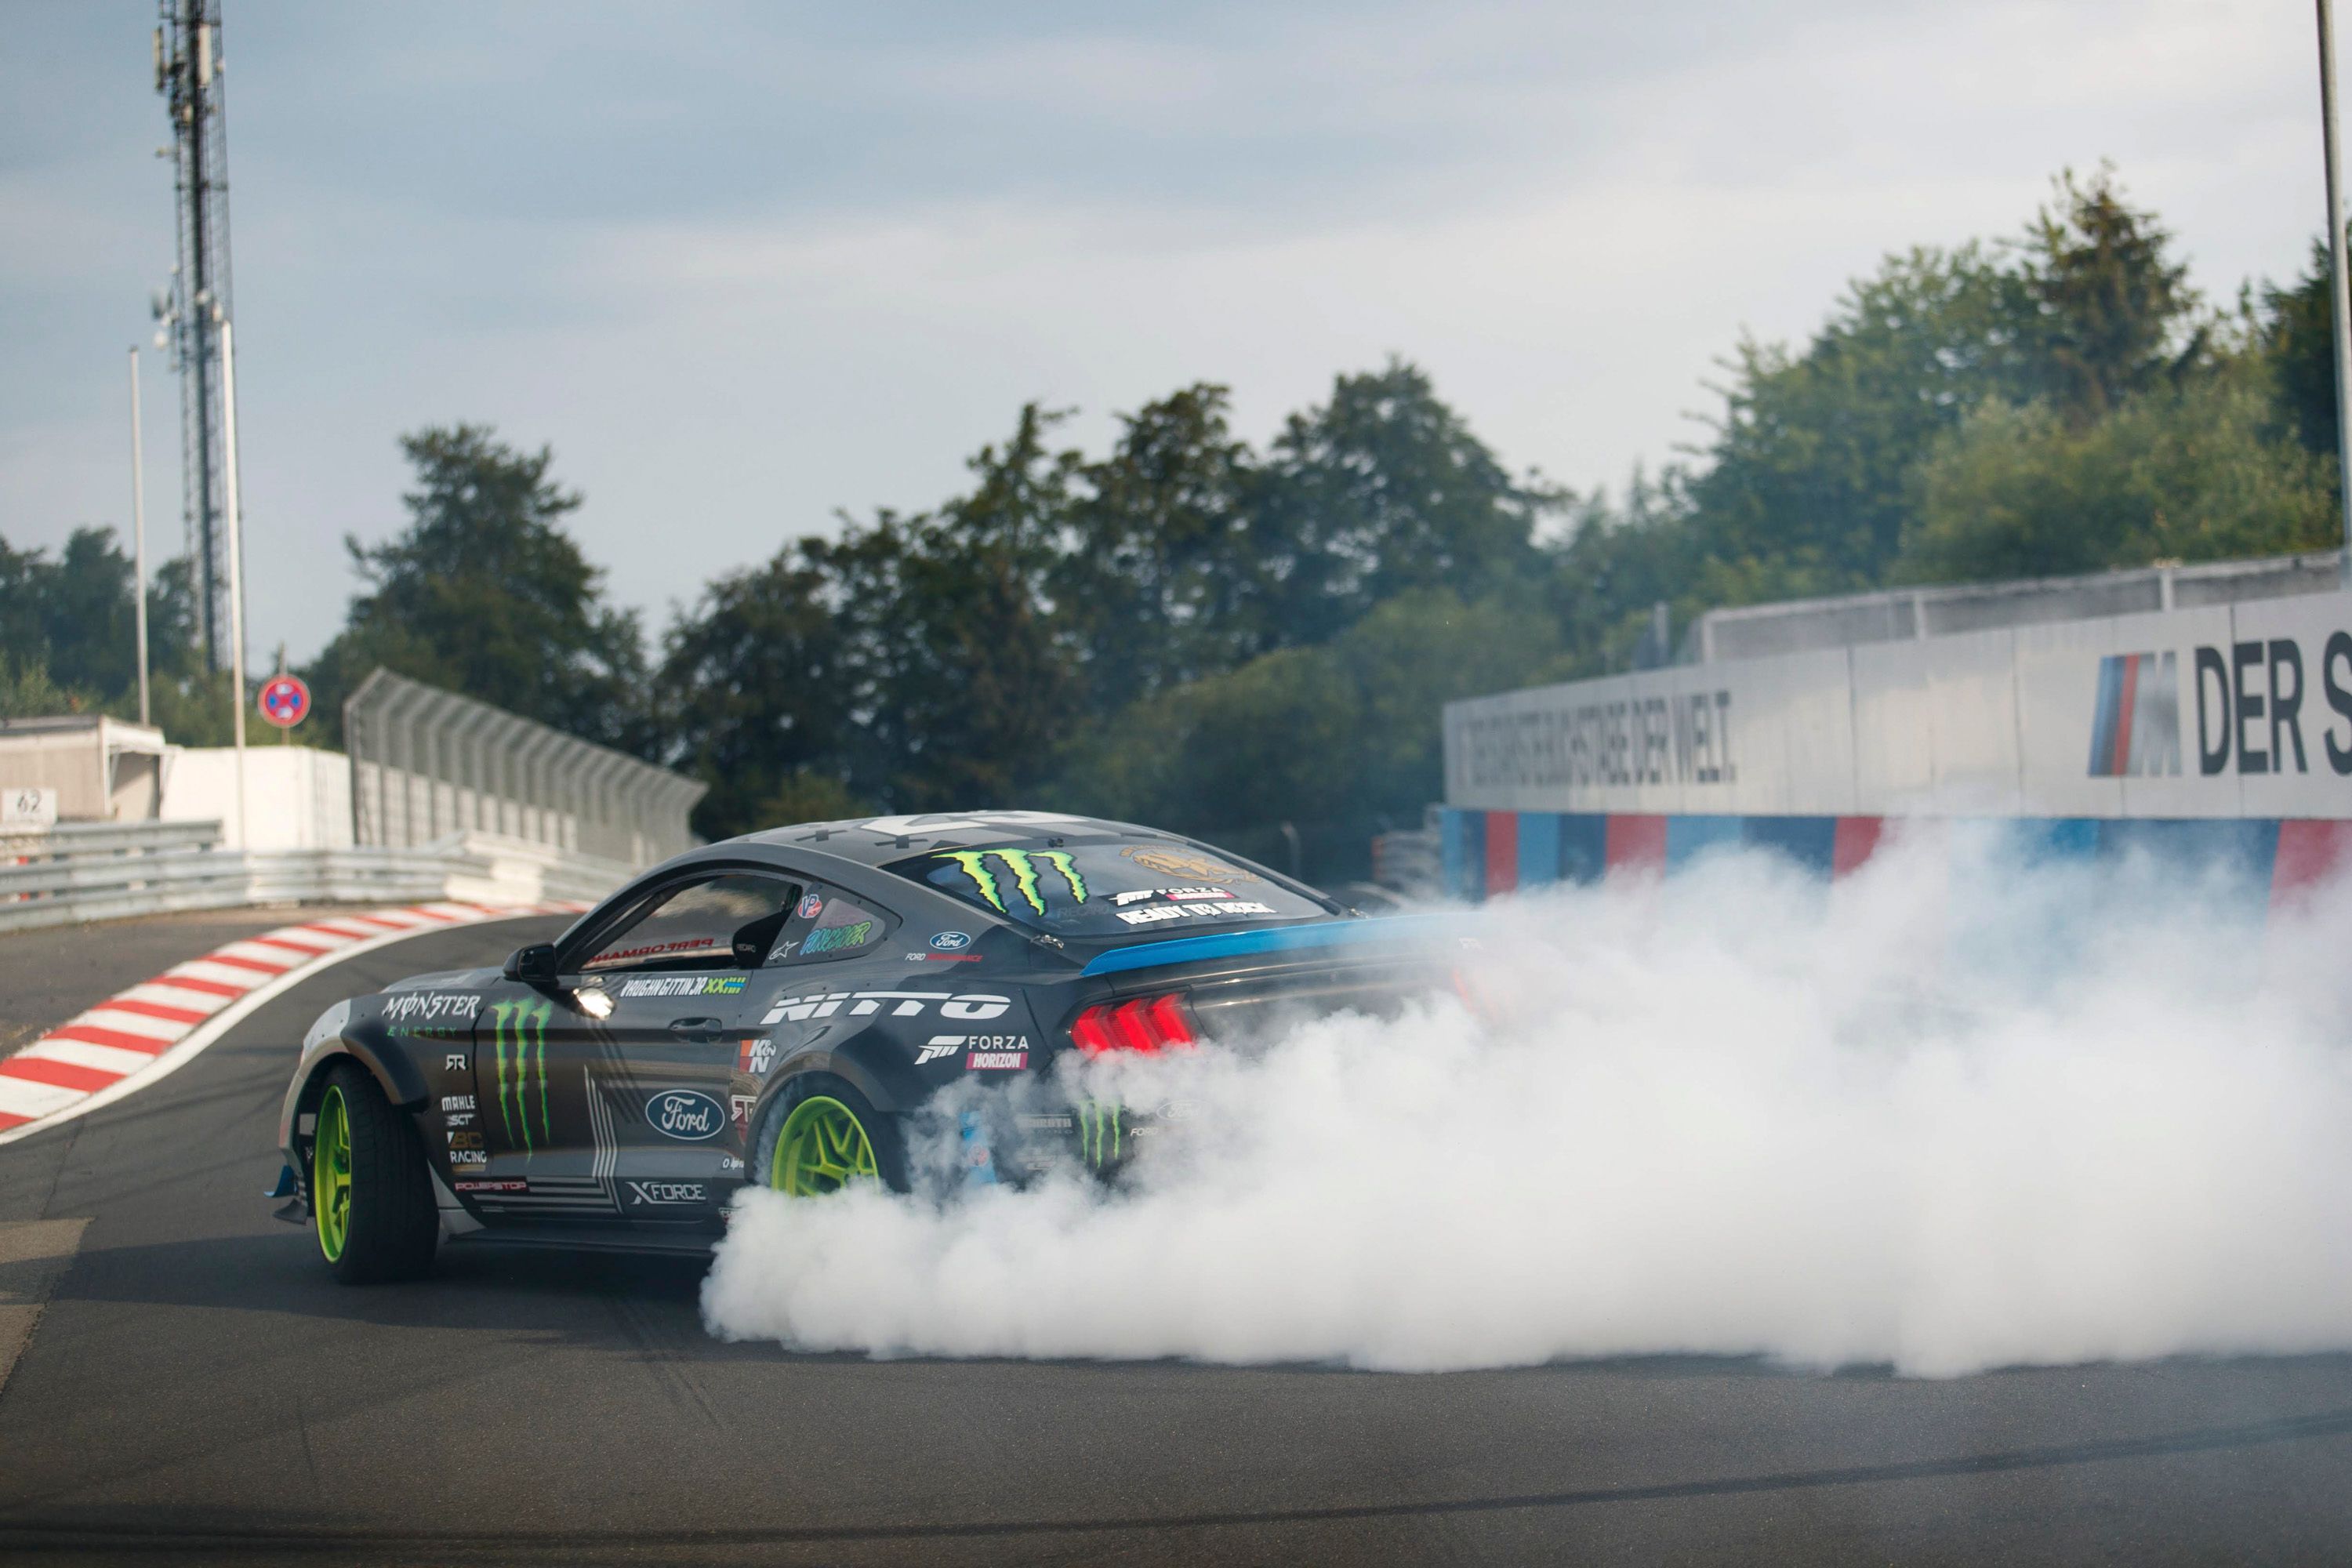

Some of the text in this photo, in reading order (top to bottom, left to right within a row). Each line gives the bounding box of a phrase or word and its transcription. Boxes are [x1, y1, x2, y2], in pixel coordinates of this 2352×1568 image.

[2194, 638, 2308, 776] DER
[1156, 887, 1225, 895] FORZA
[1116, 905, 1191, 925] READY
[1182, 903, 1222, 916] TO
[935, 934, 964, 947] Ford
[620, 980, 665, 997] VAUGHN
[688, 976, 709, 996] JR
[760, 992, 1011, 1025] NITTO
[387, 1025, 457, 1039] ENERGY
[968, 1036, 1029, 1050] FORZA
[445, 1054, 466, 1071] RTR
[972, 1053, 1022, 1069] HORIZON
[441, 1095, 476, 1112] MAHLE
[448, 1114, 475, 1127] SCT
[662, 1096, 710, 1131] Ford
[1130, 1127, 1160, 1137] FORD
[450, 1150, 488, 1164] RACING
